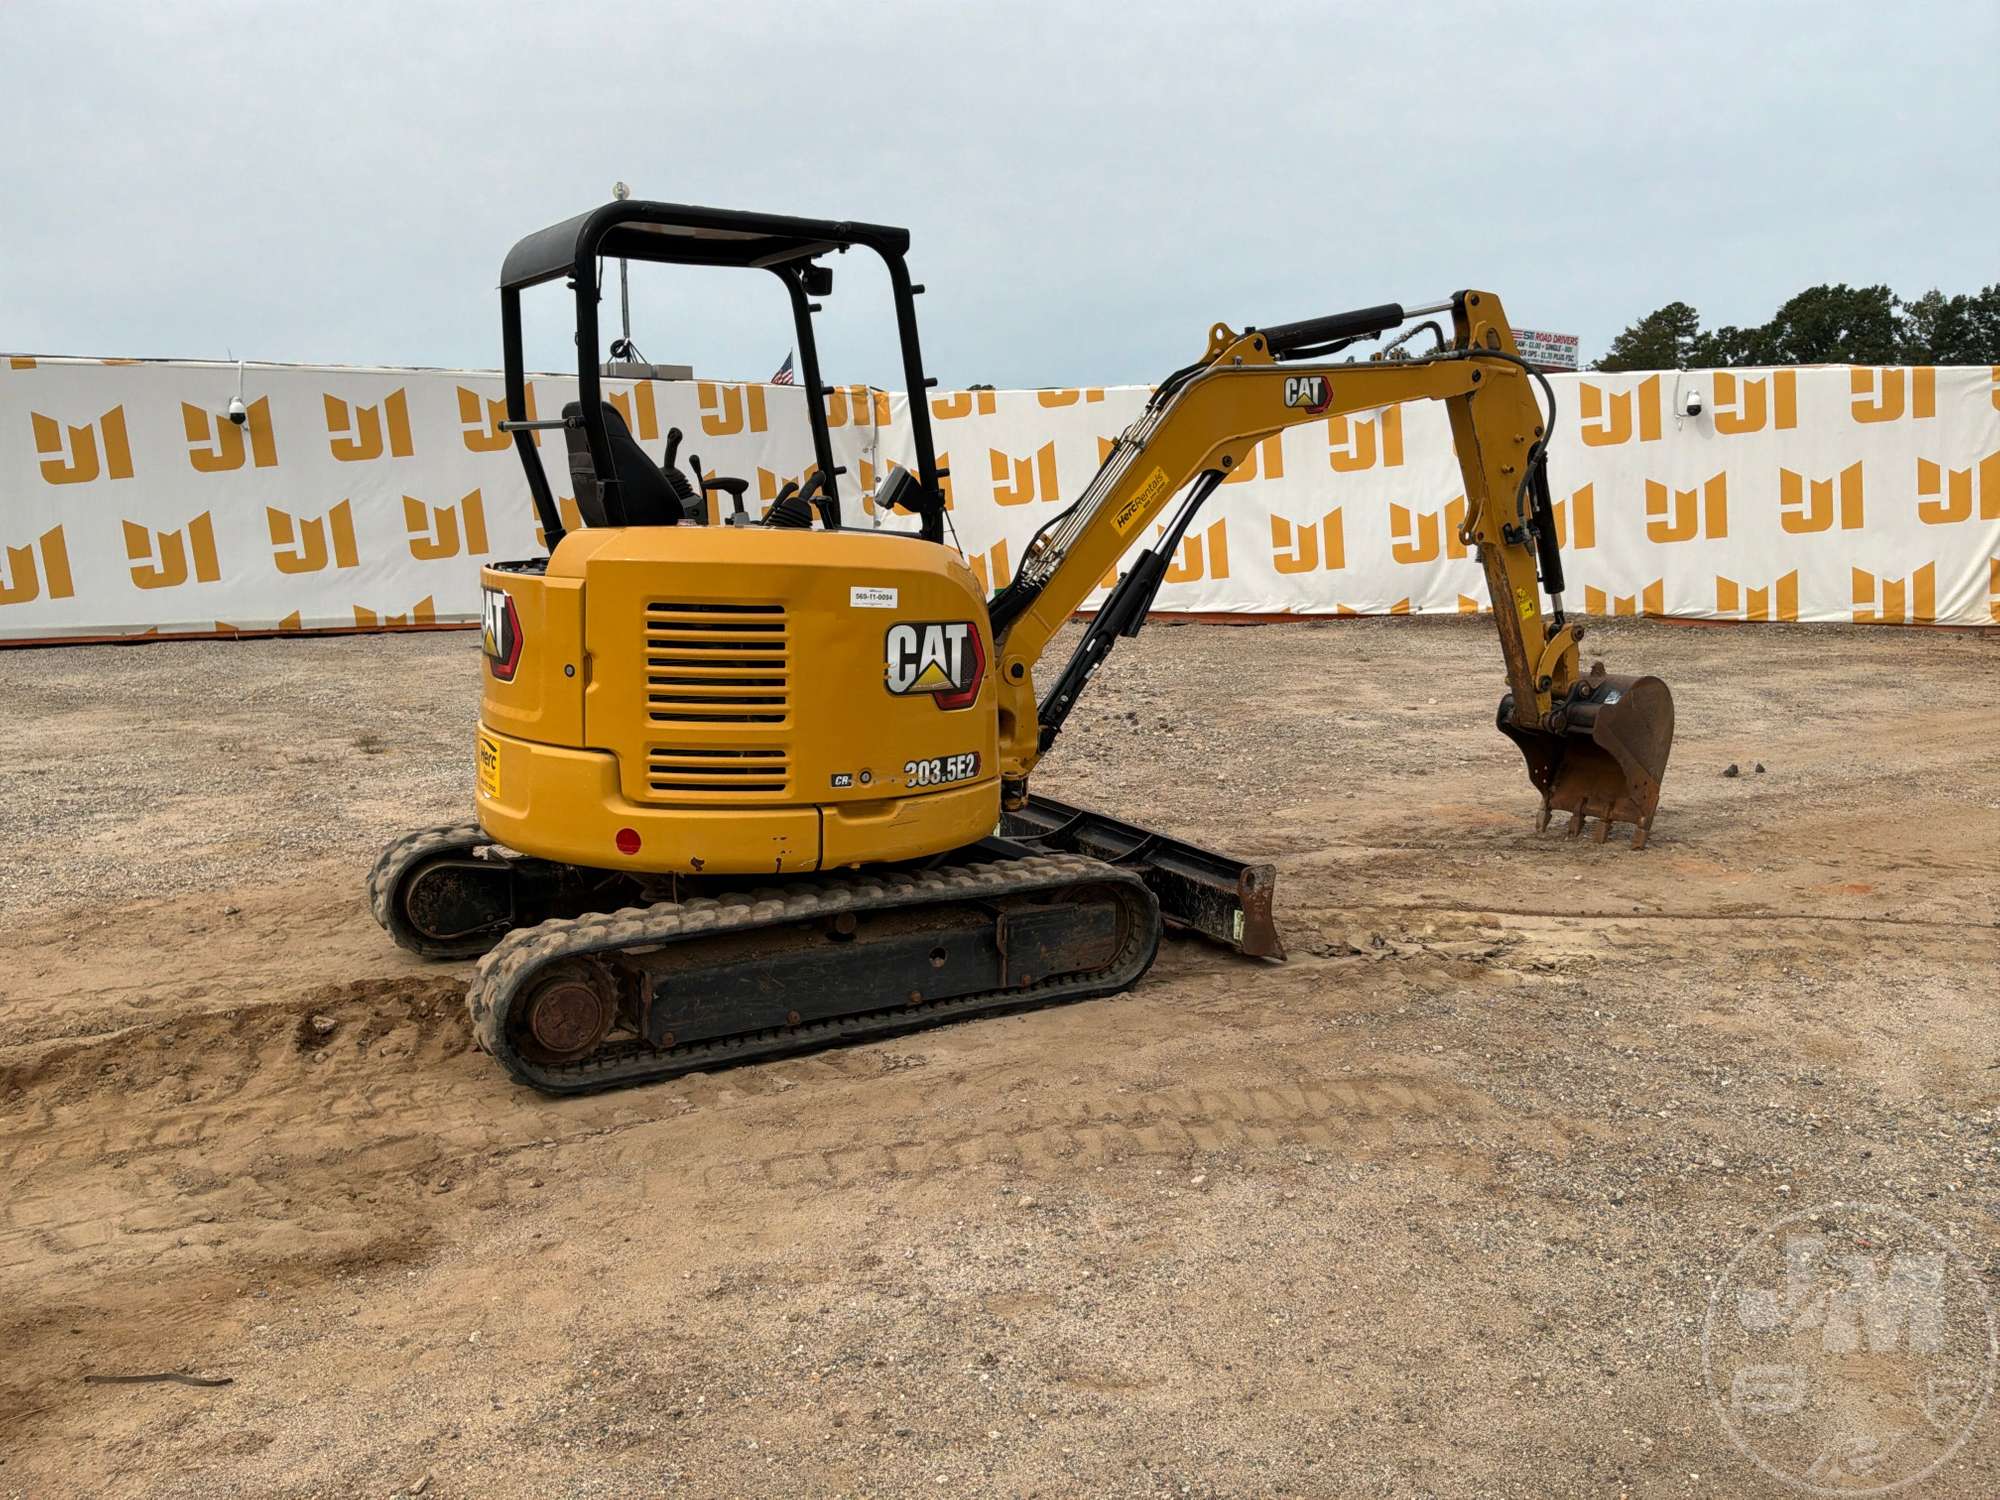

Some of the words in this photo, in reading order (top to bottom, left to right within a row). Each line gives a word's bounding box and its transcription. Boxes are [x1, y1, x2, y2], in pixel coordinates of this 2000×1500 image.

[1535, 333, 1552, 343] ROAD
[1553, 335, 1578, 346] DRIVERS
[1285, 377, 1322, 407] CAT
[481, 586, 506, 658] AT
[887, 624, 968, 693] CAT
[905, 754, 976, 787] 303.5E2
